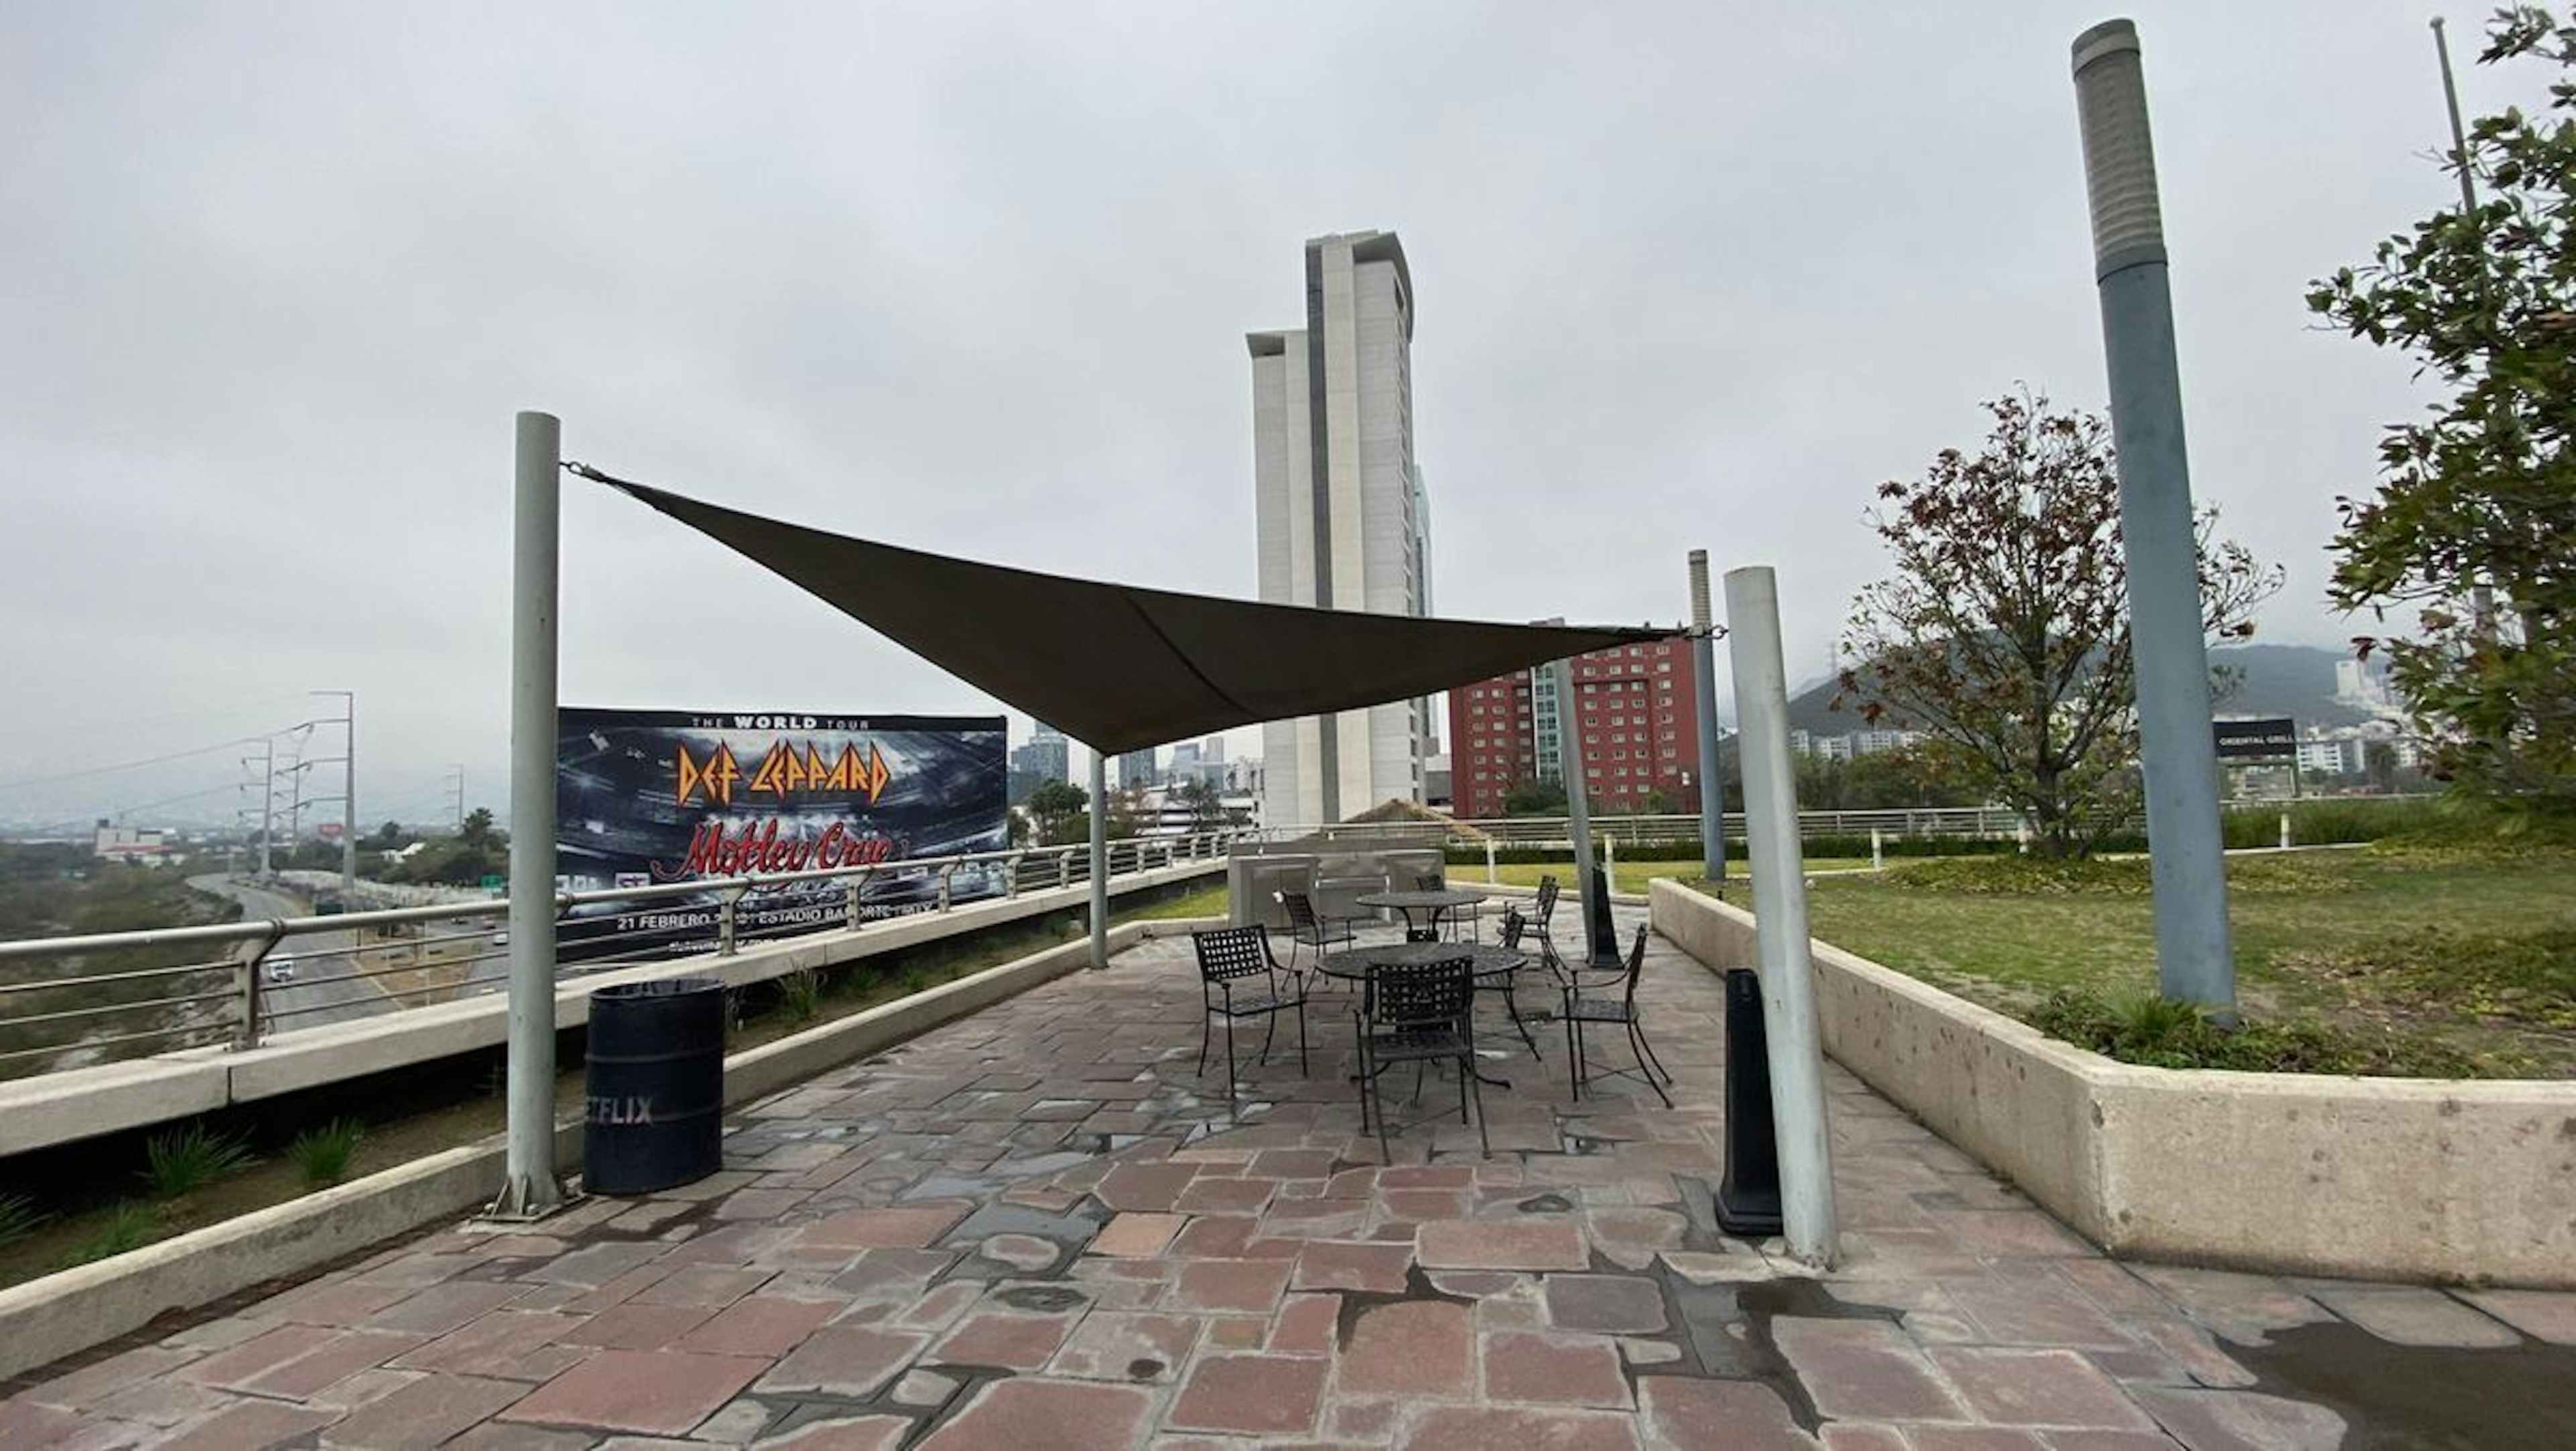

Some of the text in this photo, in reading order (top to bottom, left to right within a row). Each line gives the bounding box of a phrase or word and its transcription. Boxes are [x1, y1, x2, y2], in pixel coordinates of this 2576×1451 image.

[692, 716, 869, 730] THE WORLD TOUR
[678, 738, 891, 807] DEF LEPPARD
[616, 918, 635, 930] 21
[639, 913, 710, 928] FEBRERO
[759, 908, 821, 924] ESTADIO
[824, 904, 891, 920] BAORTE
